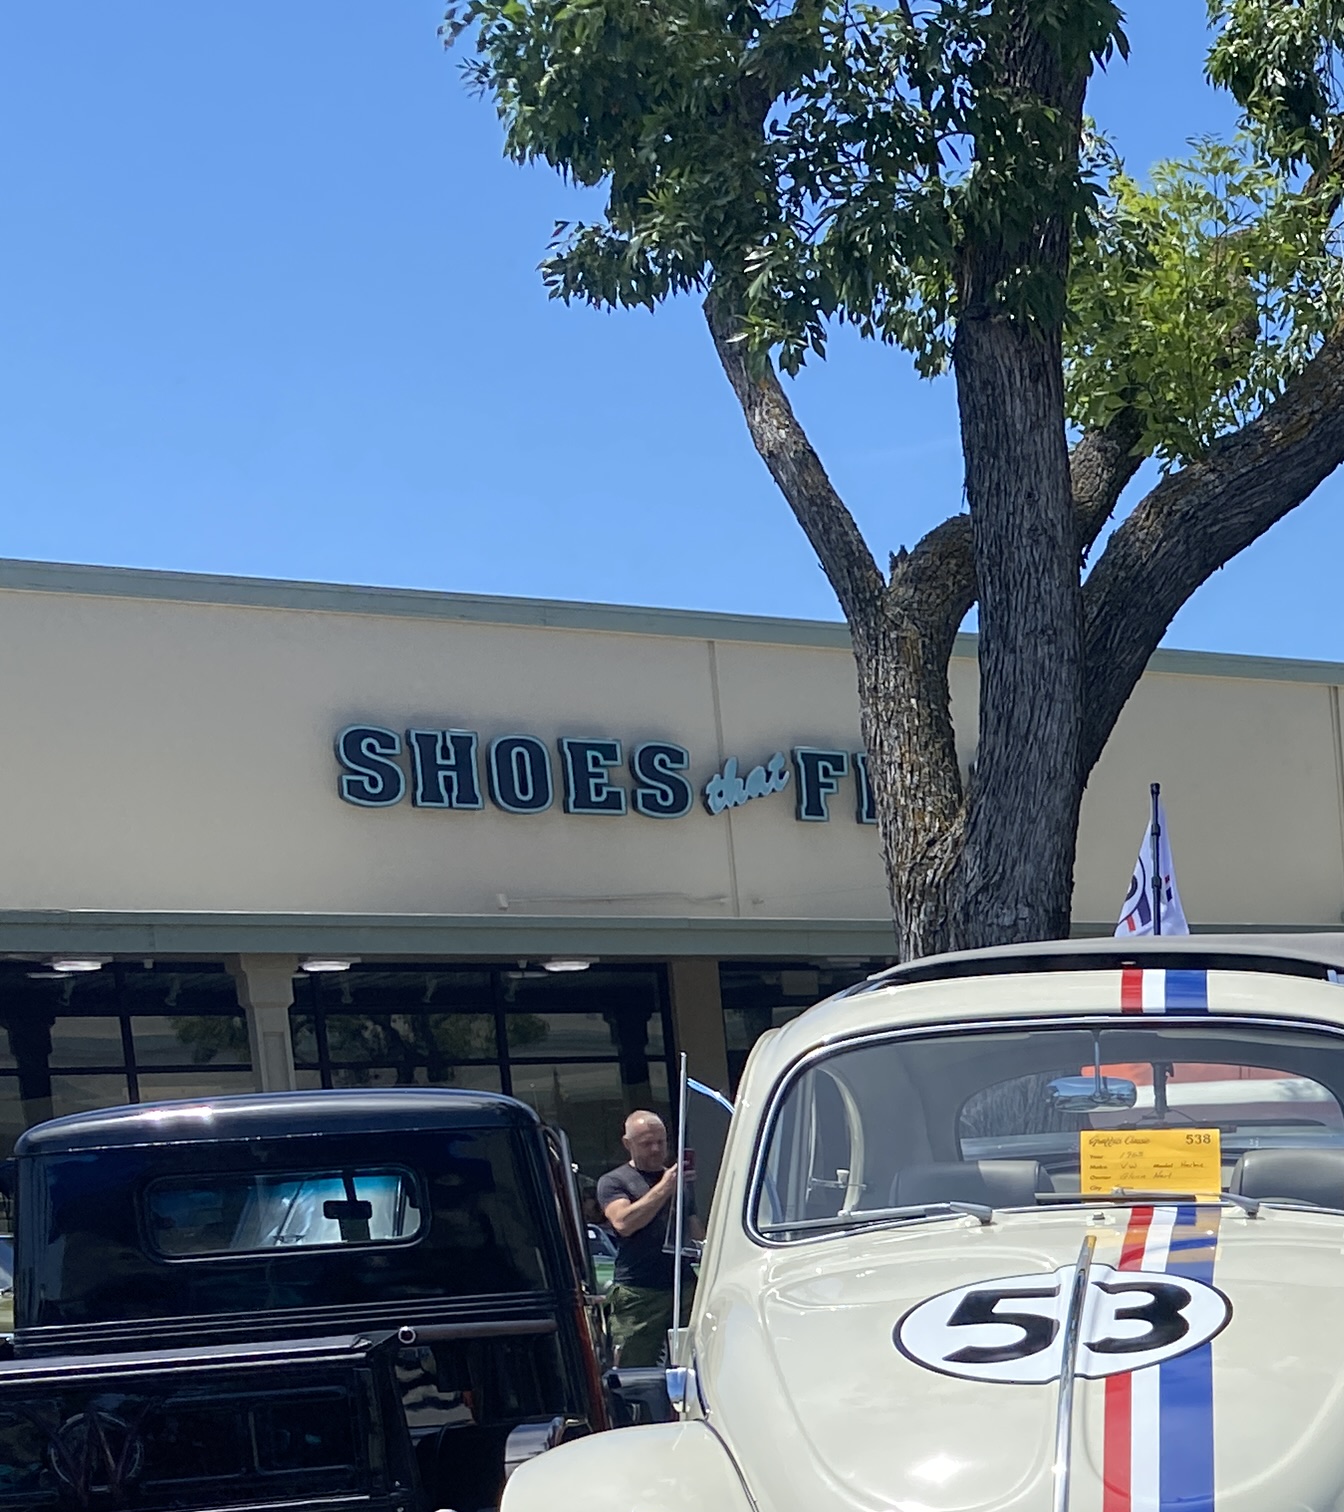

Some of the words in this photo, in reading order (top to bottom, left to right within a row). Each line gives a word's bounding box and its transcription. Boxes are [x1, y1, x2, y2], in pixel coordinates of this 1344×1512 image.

[337, 725, 694, 819] SHOES
[704, 751, 789, 816] that
[1186, 1134, 1211, 1145] 538
[942, 1281, 1192, 1364] 53
